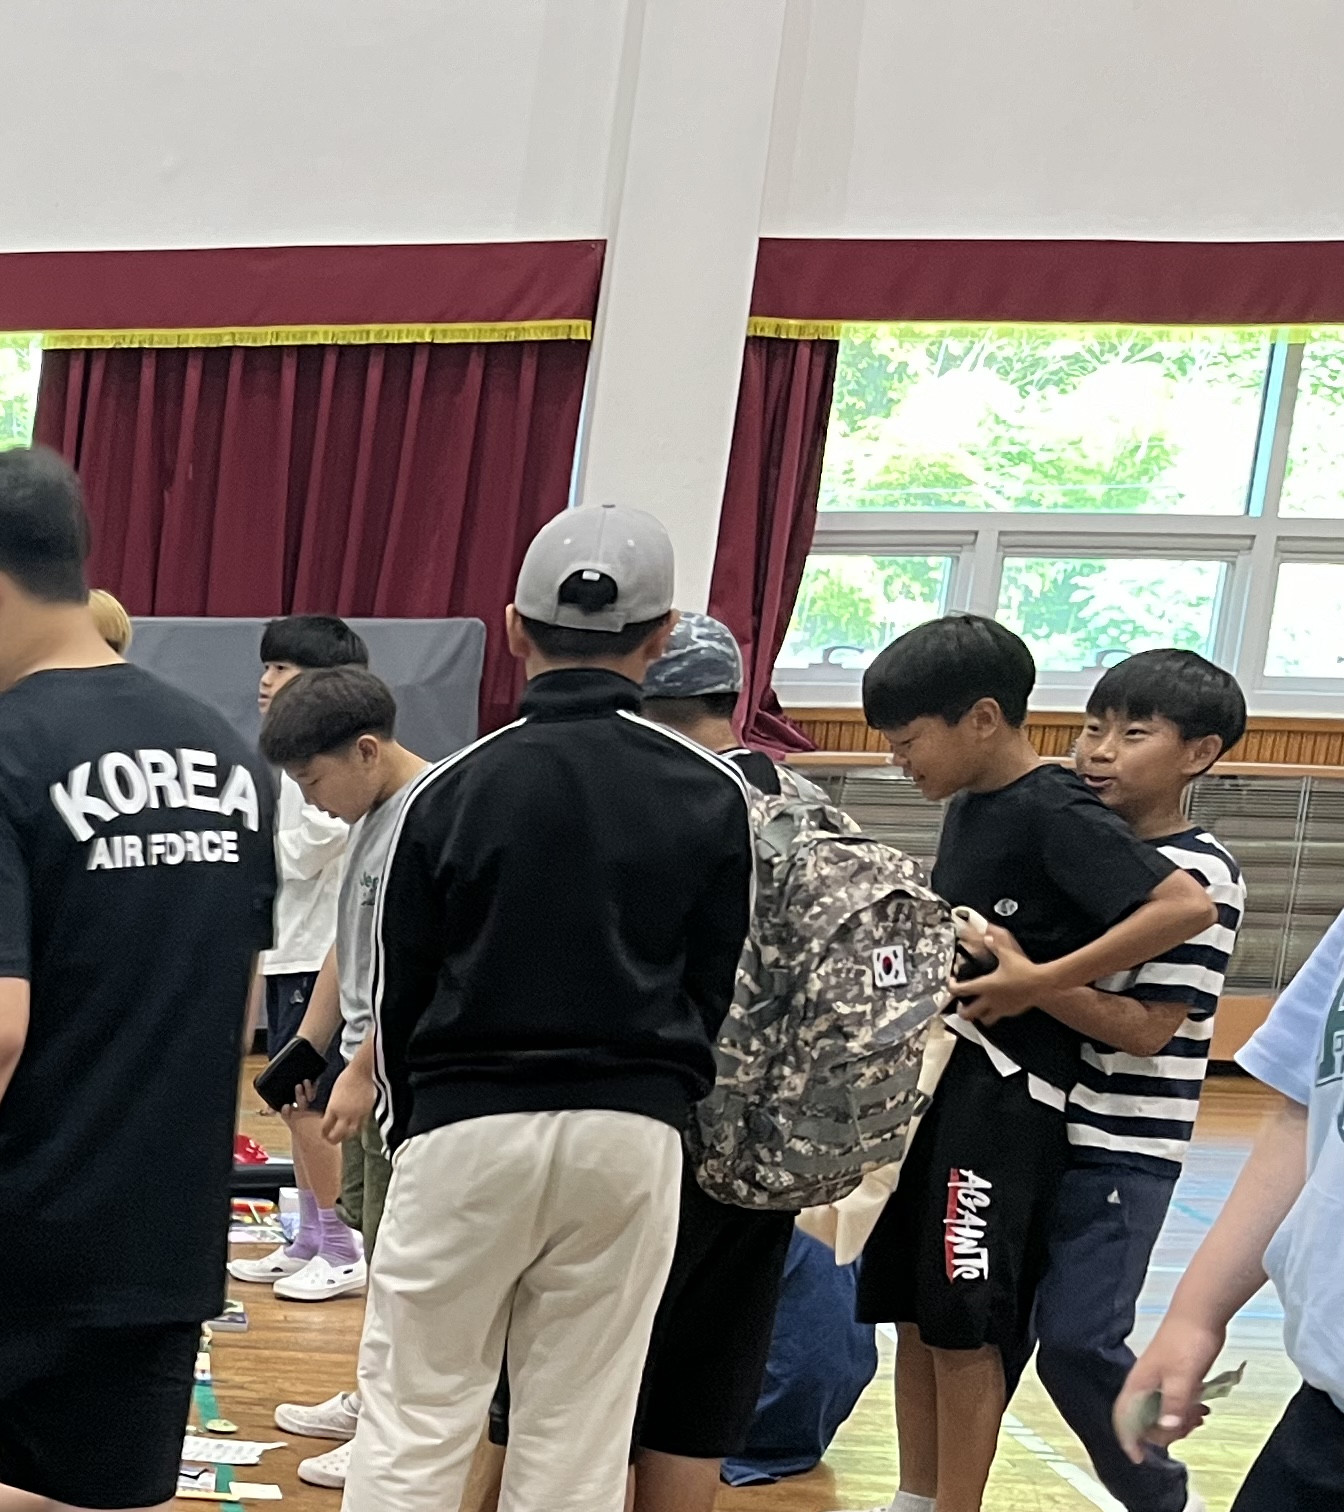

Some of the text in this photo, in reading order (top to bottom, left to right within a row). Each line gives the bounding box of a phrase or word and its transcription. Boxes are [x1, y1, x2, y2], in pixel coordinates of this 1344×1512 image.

[49, 747, 260, 842] KOREA
[86, 829, 240, 871] AIR FORCE
